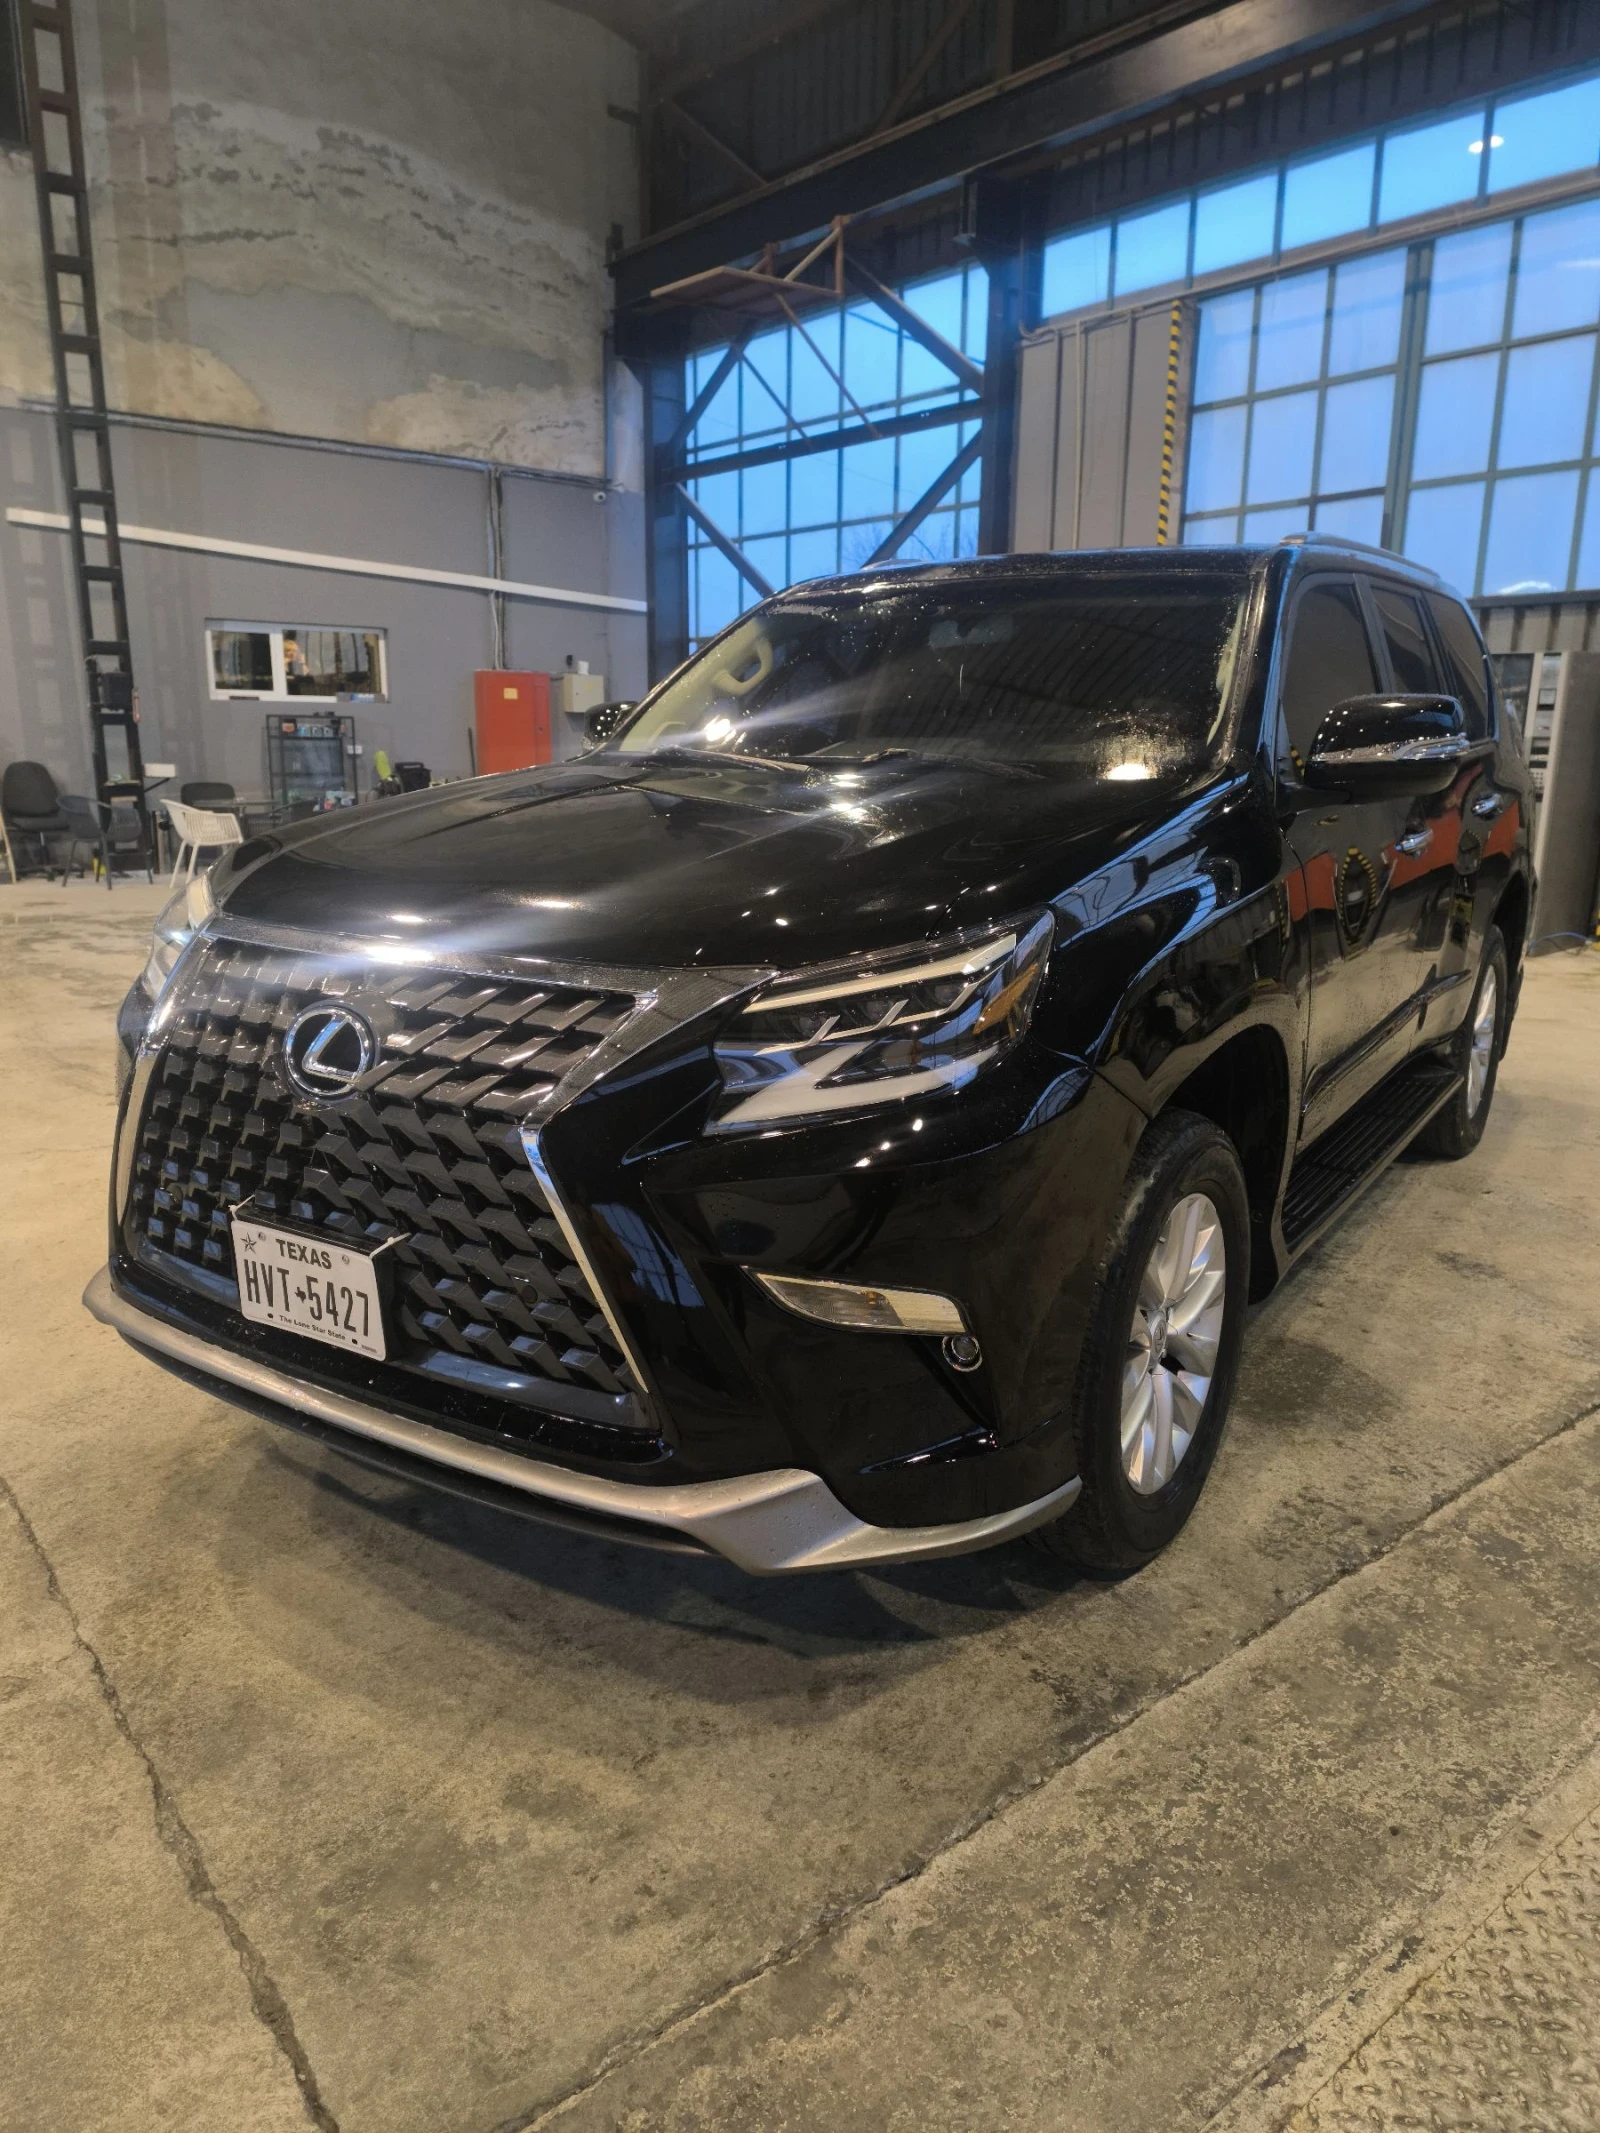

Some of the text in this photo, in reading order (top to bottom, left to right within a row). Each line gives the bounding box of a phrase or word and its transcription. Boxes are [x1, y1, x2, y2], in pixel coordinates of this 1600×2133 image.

[275, 1238, 332, 1270] TEXAS
[279, 1314, 346, 1340] The Lone Star State
